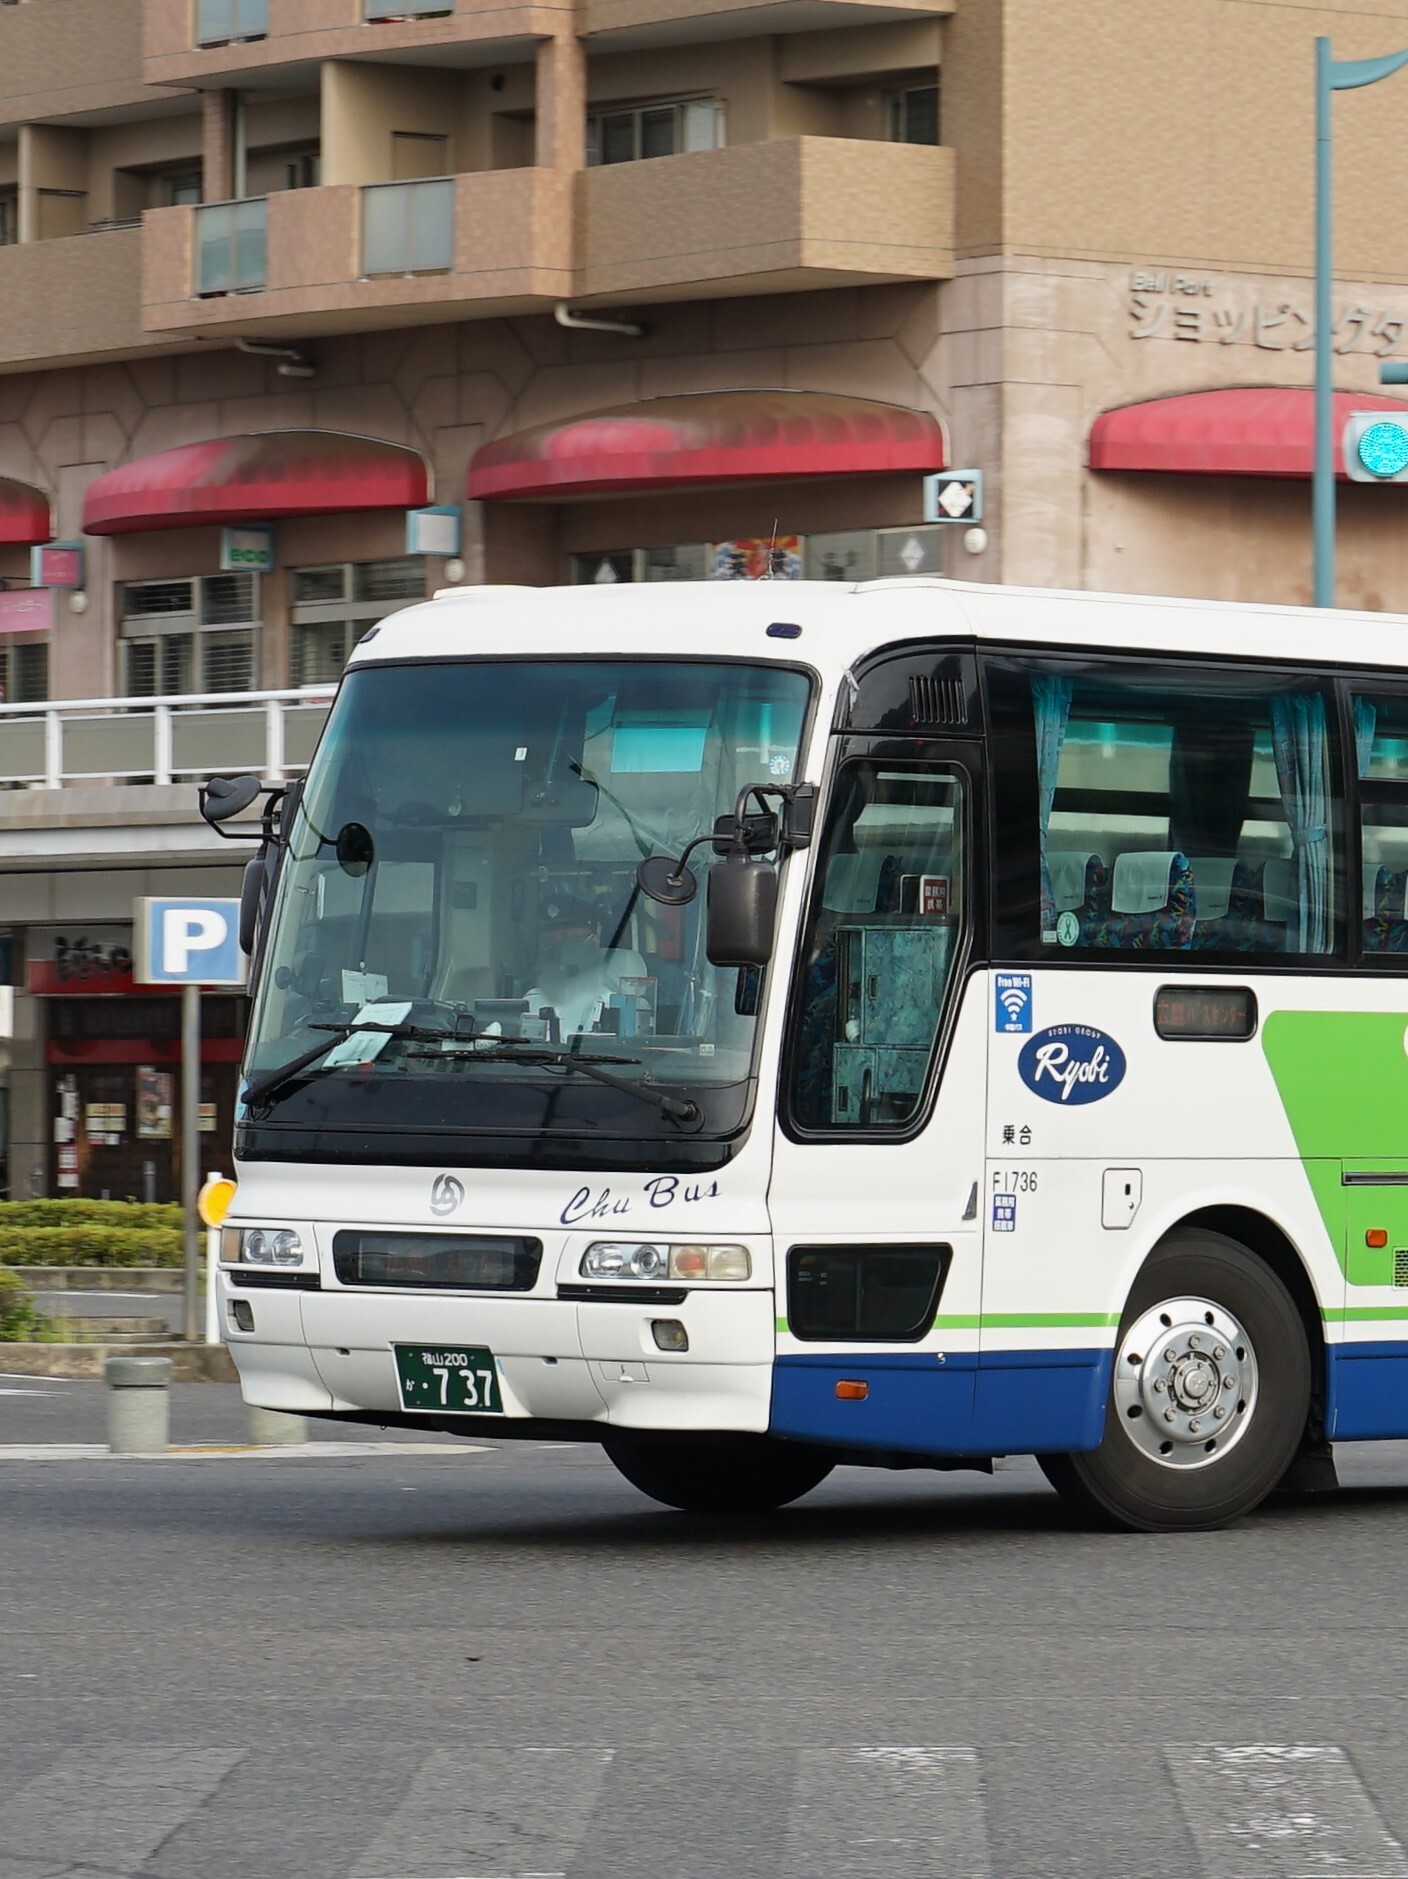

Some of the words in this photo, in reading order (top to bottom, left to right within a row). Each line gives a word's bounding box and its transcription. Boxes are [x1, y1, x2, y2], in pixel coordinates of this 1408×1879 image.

[162, 908, 228, 973] P
[1035, 1042, 1110, 1101] Ryobi
[1002, 1124, 1032, 1145] 乗合
[560, 1186, 633, 1225] Chu
[643, 1176, 722, 1208] Bus
[993, 1171, 1038, 1193] F1736
